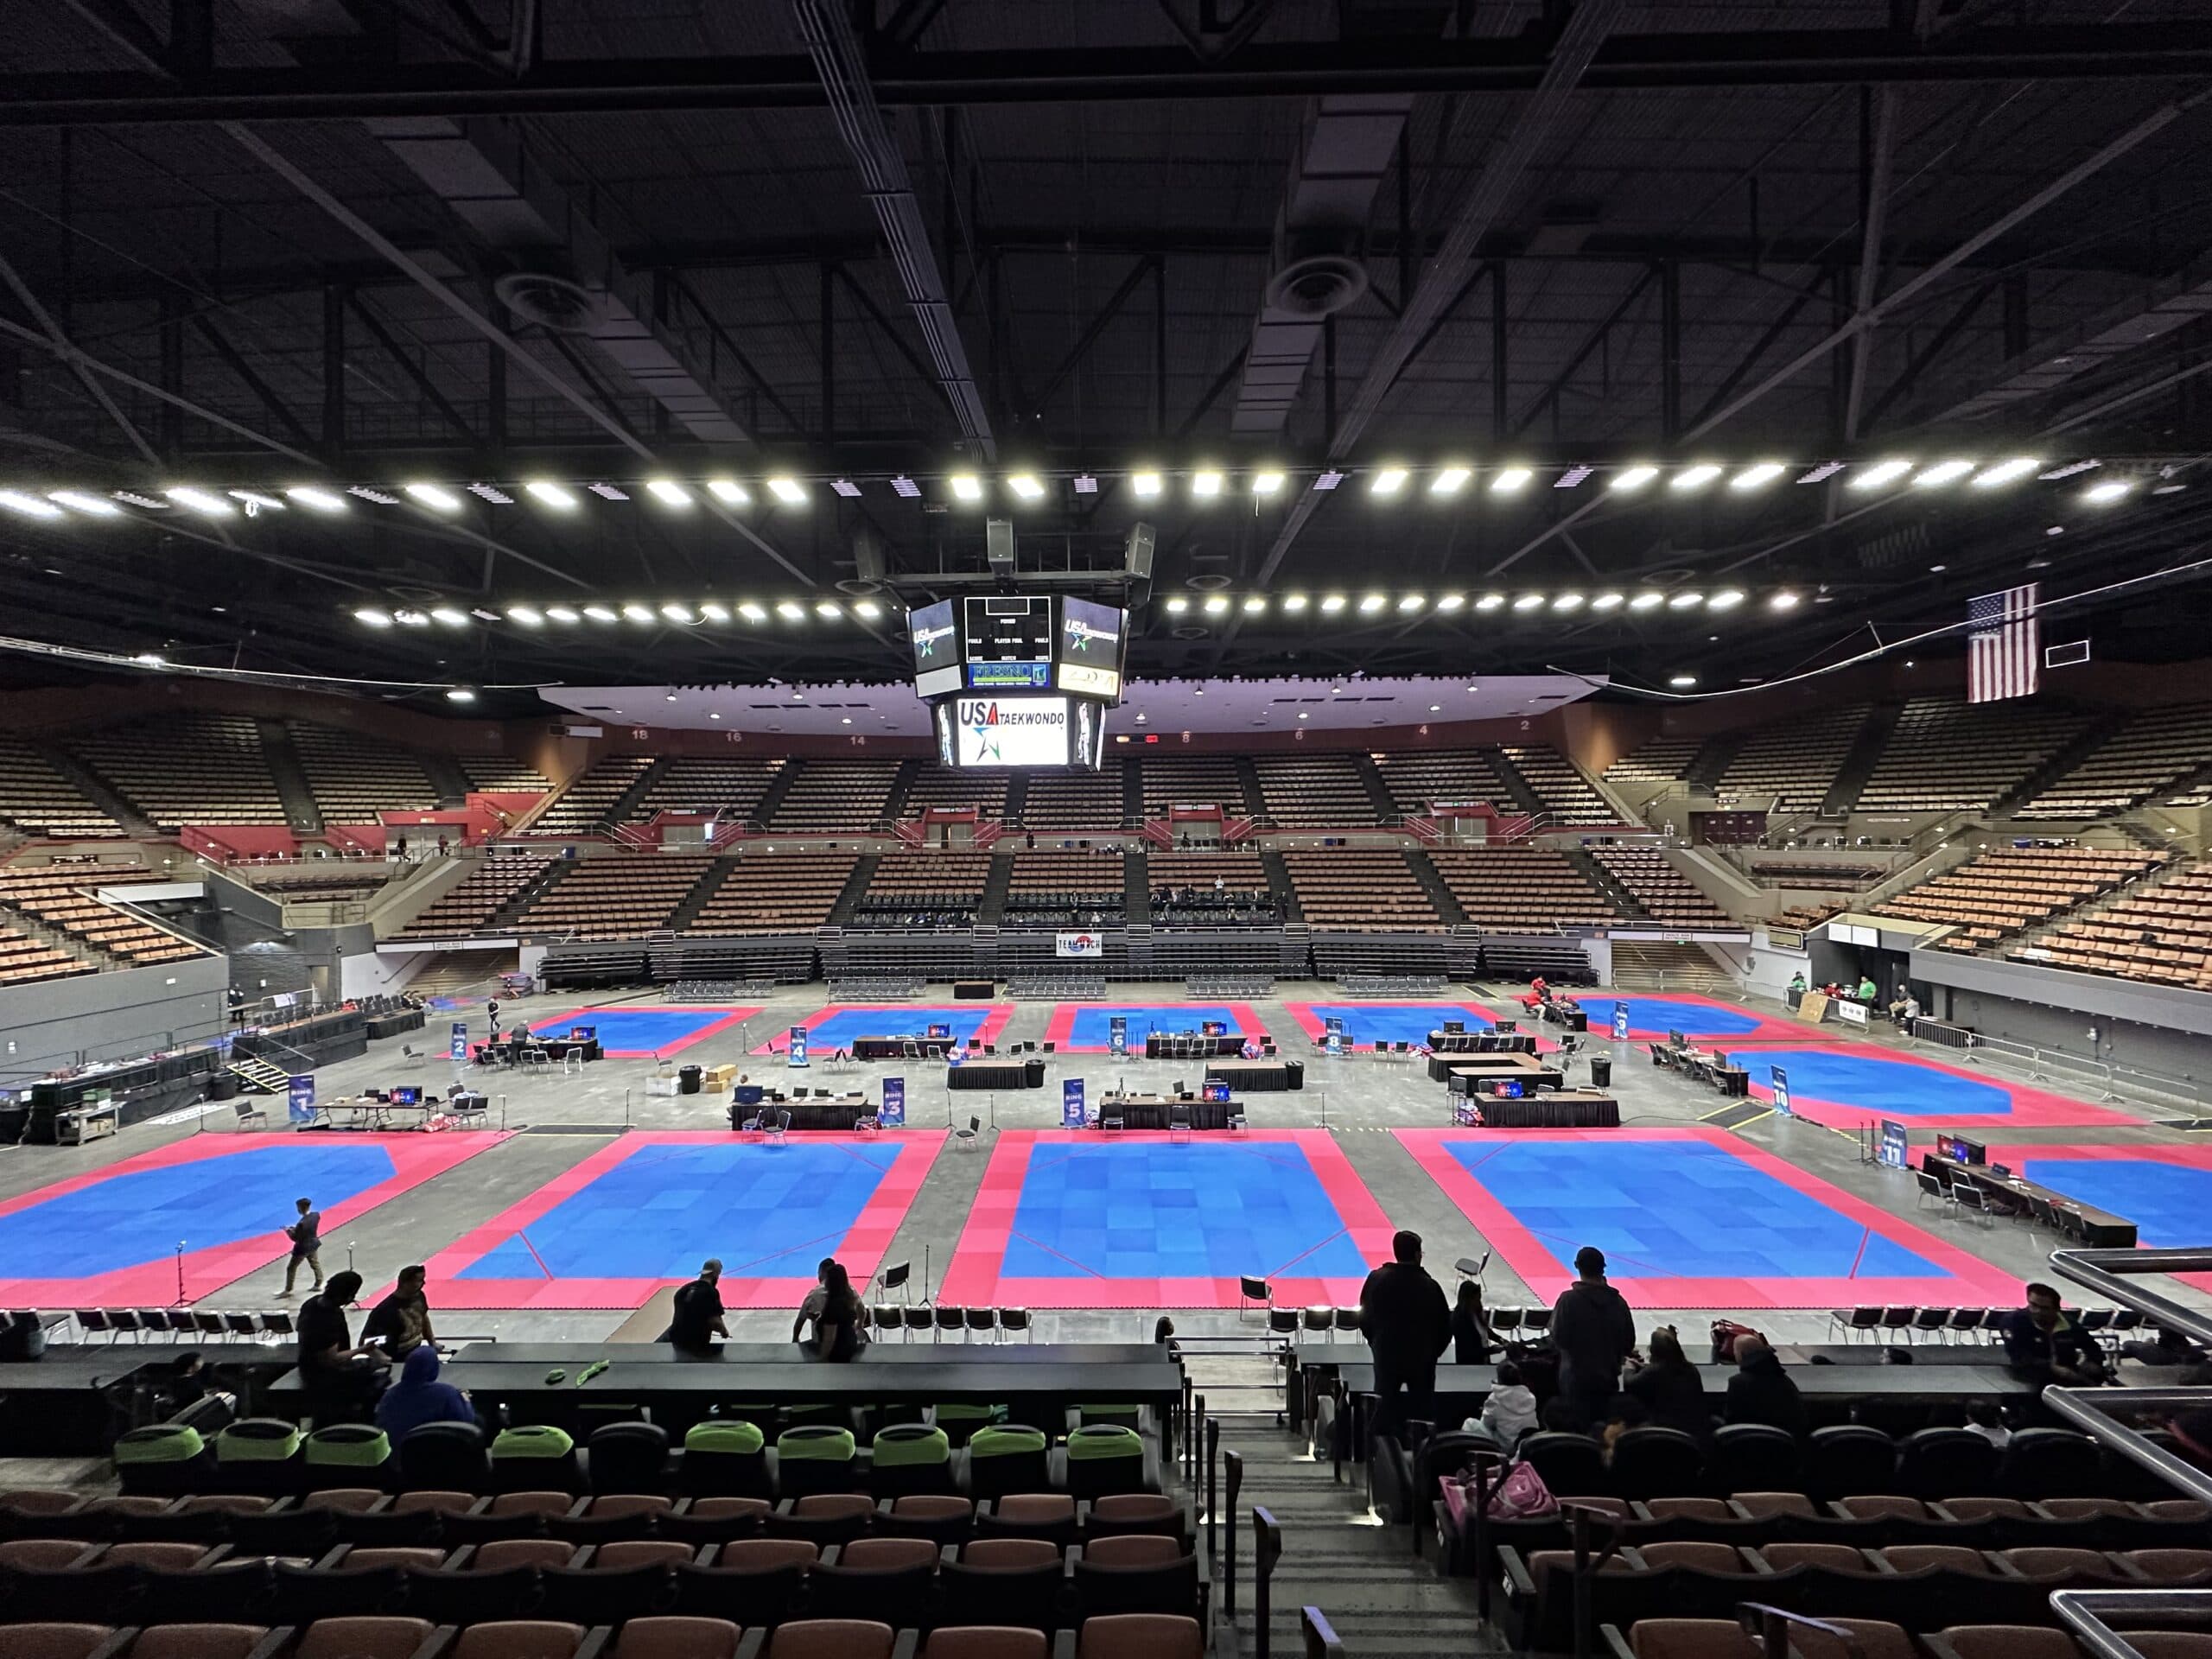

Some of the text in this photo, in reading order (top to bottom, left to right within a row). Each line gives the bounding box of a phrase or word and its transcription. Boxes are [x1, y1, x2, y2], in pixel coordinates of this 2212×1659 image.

[1065, 619, 1087, 634] USA
[975, 664, 1032, 677] FRESNO
[960, 702, 1065, 726] USA TAEKWONDO
[1420, 725, 1427, 734] 4
[1521, 721, 1529, 730] 2
[632, 730, 648, 740] 18
[726, 733, 741, 742] 16
[1182, 734, 1190, 743] 8
[1295, 732, 1303, 741] 6
[850, 736, 865, 746] 14
[1114, 1035, 1123, 1046] 6
[1329, 1036, 1339, 1047] 8
[455, 1041, 464, 1052] 2
[793, 1046, 804, 1058] 4
[1774, 1089, 1789, 1107] 10
[297, 1097, 308, 1112] 1
[888, 1101, 900, 1116] 3
[1068, 1102, 1081, 1118] 5
[1885, 1145, 1901, 1164] 11
